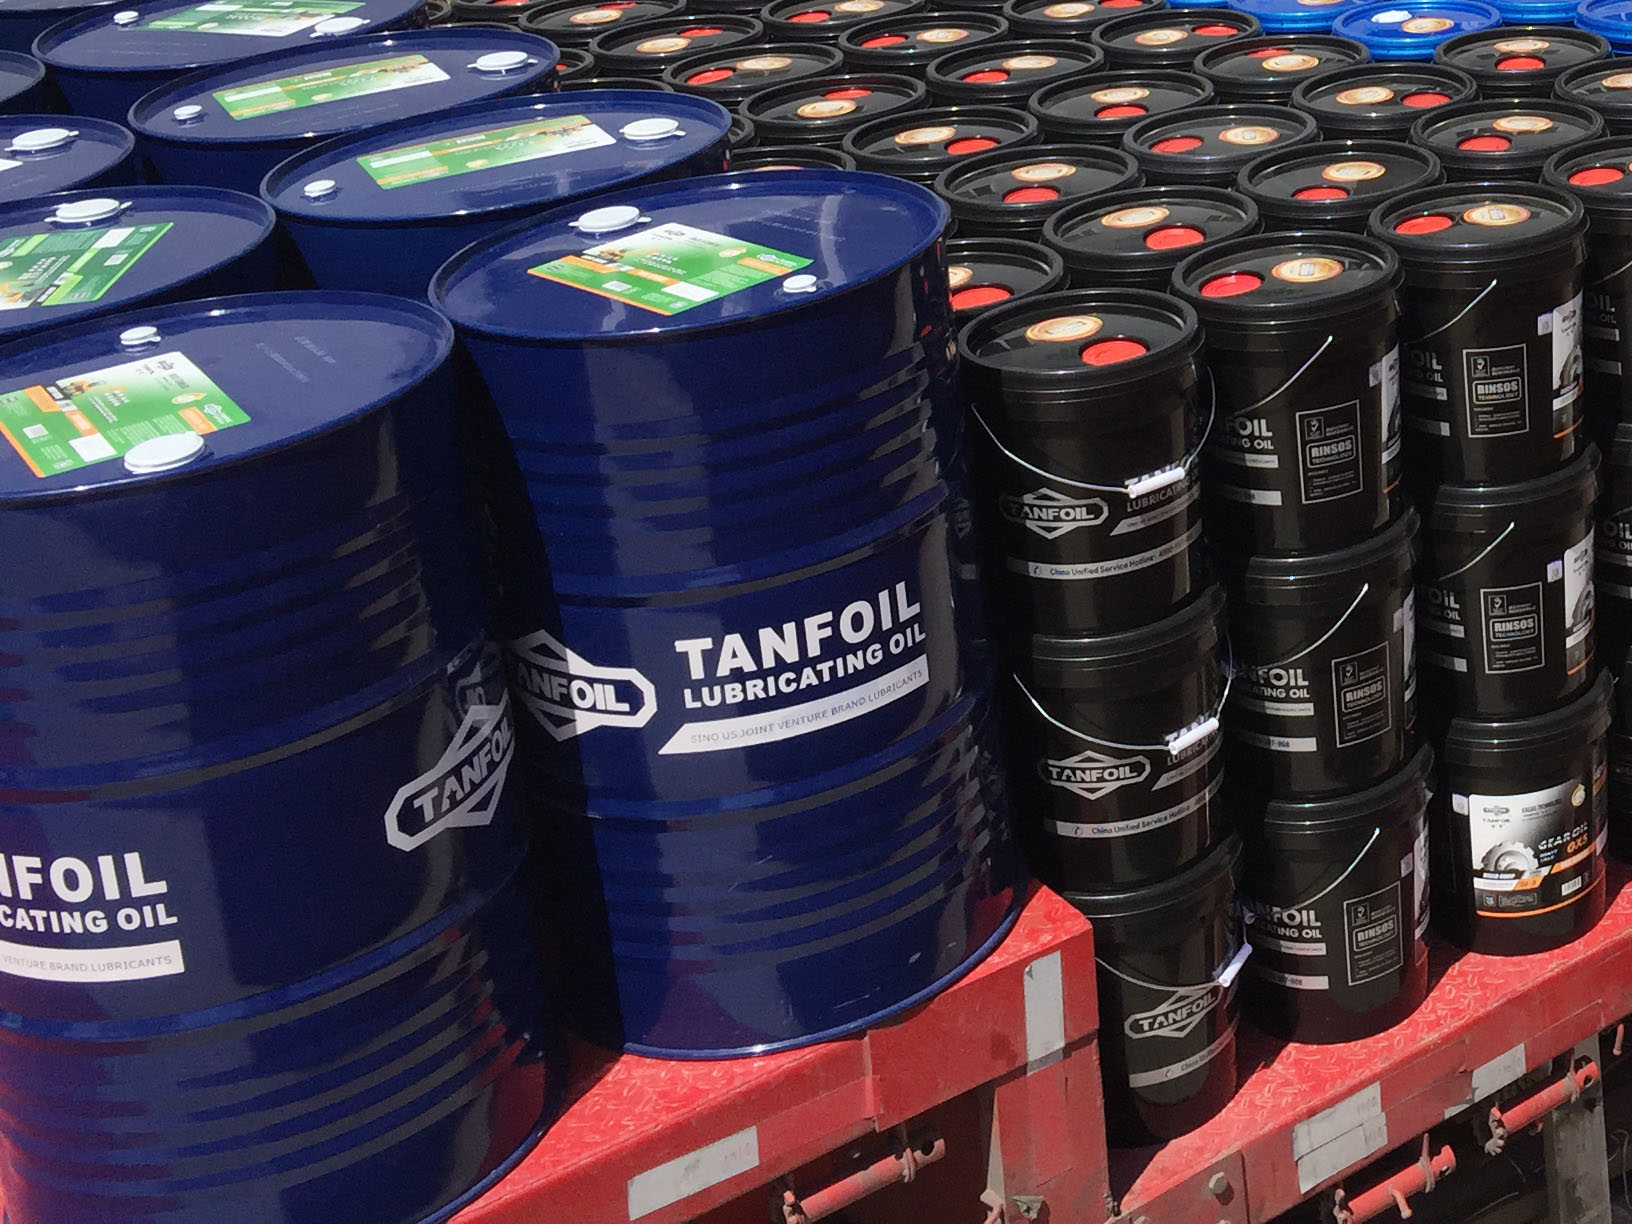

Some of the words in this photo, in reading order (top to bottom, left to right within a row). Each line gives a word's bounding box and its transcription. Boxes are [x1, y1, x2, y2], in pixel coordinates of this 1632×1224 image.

[1476, 380, 1518, 394] RINSOS
[1254, 439, 1274, 450] OIL
[1311, 439, 1353, 458] RINSOS
[1017, 505, 1095, 521] ANFOIL
[1071, 566, 1099, 577] Unified
[1100, 562, 1129, 574] Service
[674, 580, 921, 680] TANFOIL
[1493, 617, 1535, 632] RINSOS
[683, 642, 884, 709] LUBRICATING
[888, 623, 927, 655] OIL
[519, 662, 630, 713] ANFOIL
[1289, 688, 1310, 698] OIL
[1345, 680, 1383, 702] RINSOS
[690, 731, 720, 745] SINO
[721, 730, 738, 742] US
[738, 722, 776, 739] JOINT
[777, 708, 829, 731] VENTURE
[830, 696, 867, 716] BRAND
[867, 669, 924, 704] LUBRICANTS
[413, 716, 514, 823] TANFOIL
[1048, 765, 1138, 782] TANFOIL
[116, 903, 178, 930] OIL
[1302, 928, 1323, 938] OIL
[1356, 920, 1394, 942] RINSOS
[2, 954, 47, 971] VENTURE
[49, 961, 88, 972] BRAND
[90, 954, 173, 972] LUBRICANTS
[1138, 991, 1216, 1031] TANFOIL
